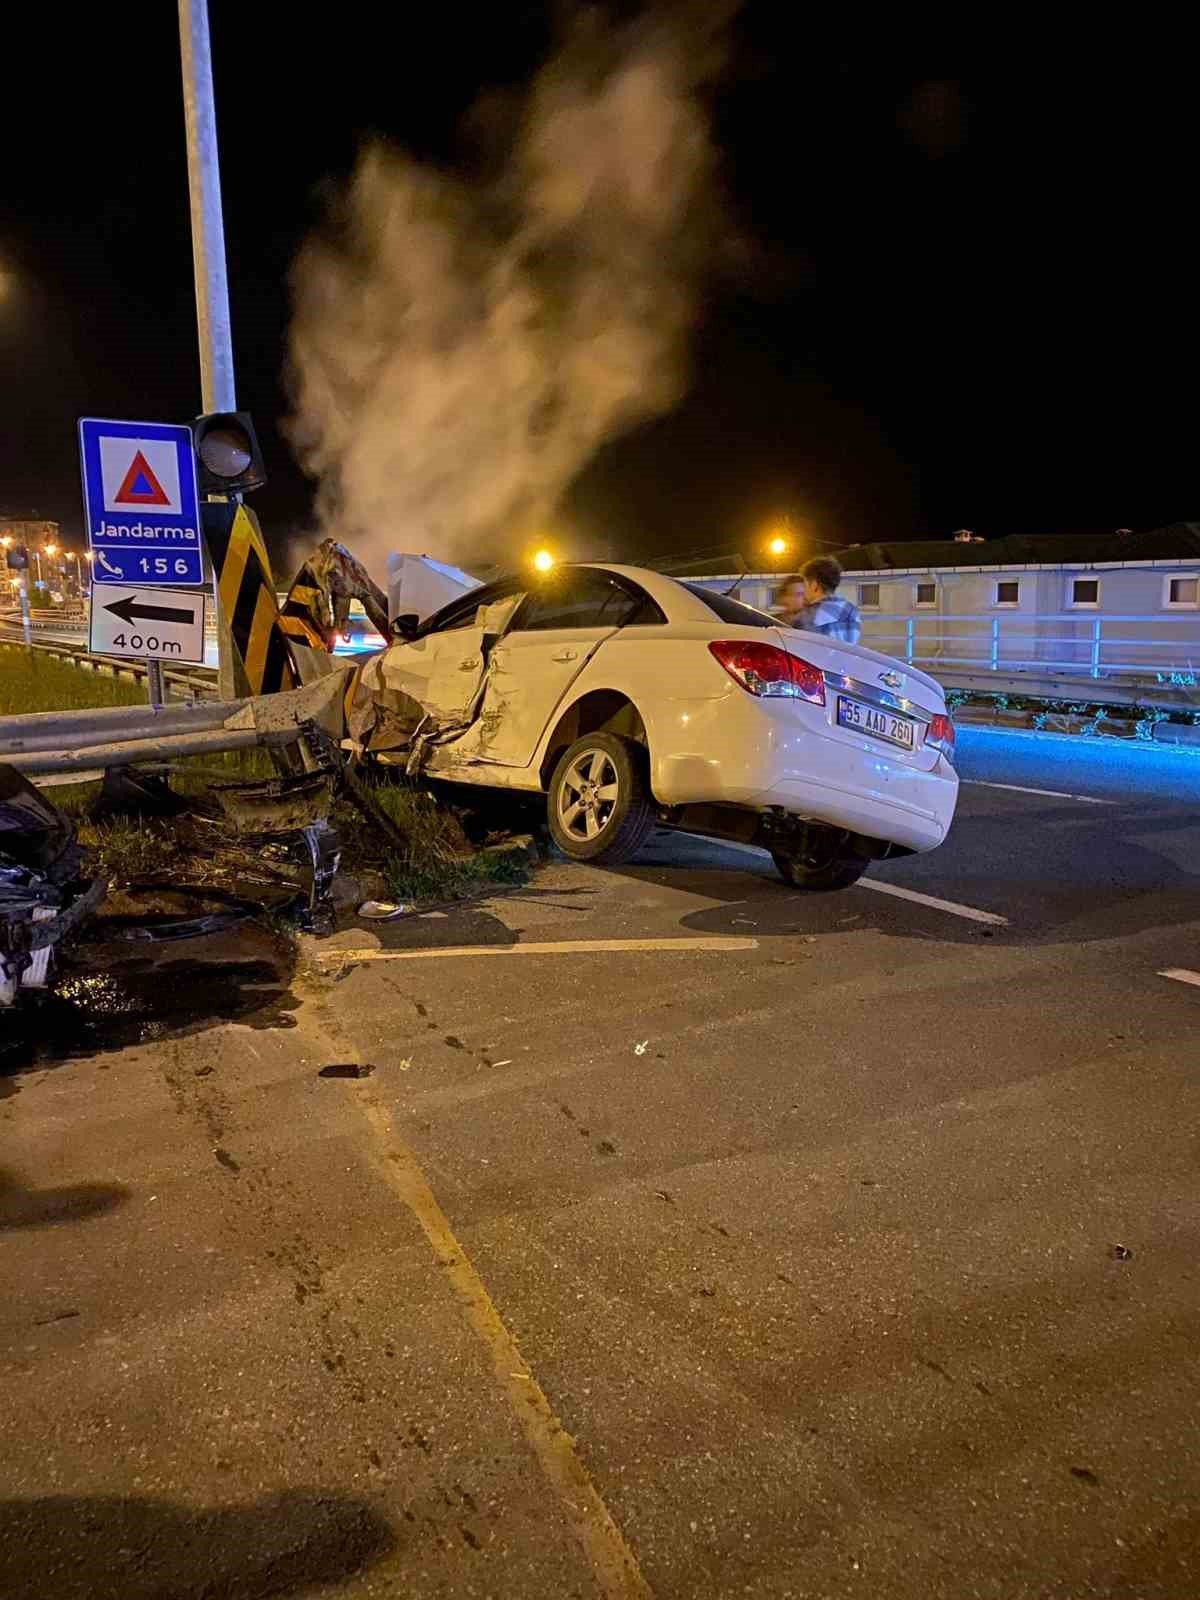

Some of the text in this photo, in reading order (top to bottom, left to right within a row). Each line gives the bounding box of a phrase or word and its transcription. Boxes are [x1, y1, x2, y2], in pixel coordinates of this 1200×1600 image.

[95, 521, 195, 540] Jandarma
[139, 558, 188, 574] 156
[113, 634, 182, 654] 400m
[847, 703, 860, 724] 55
